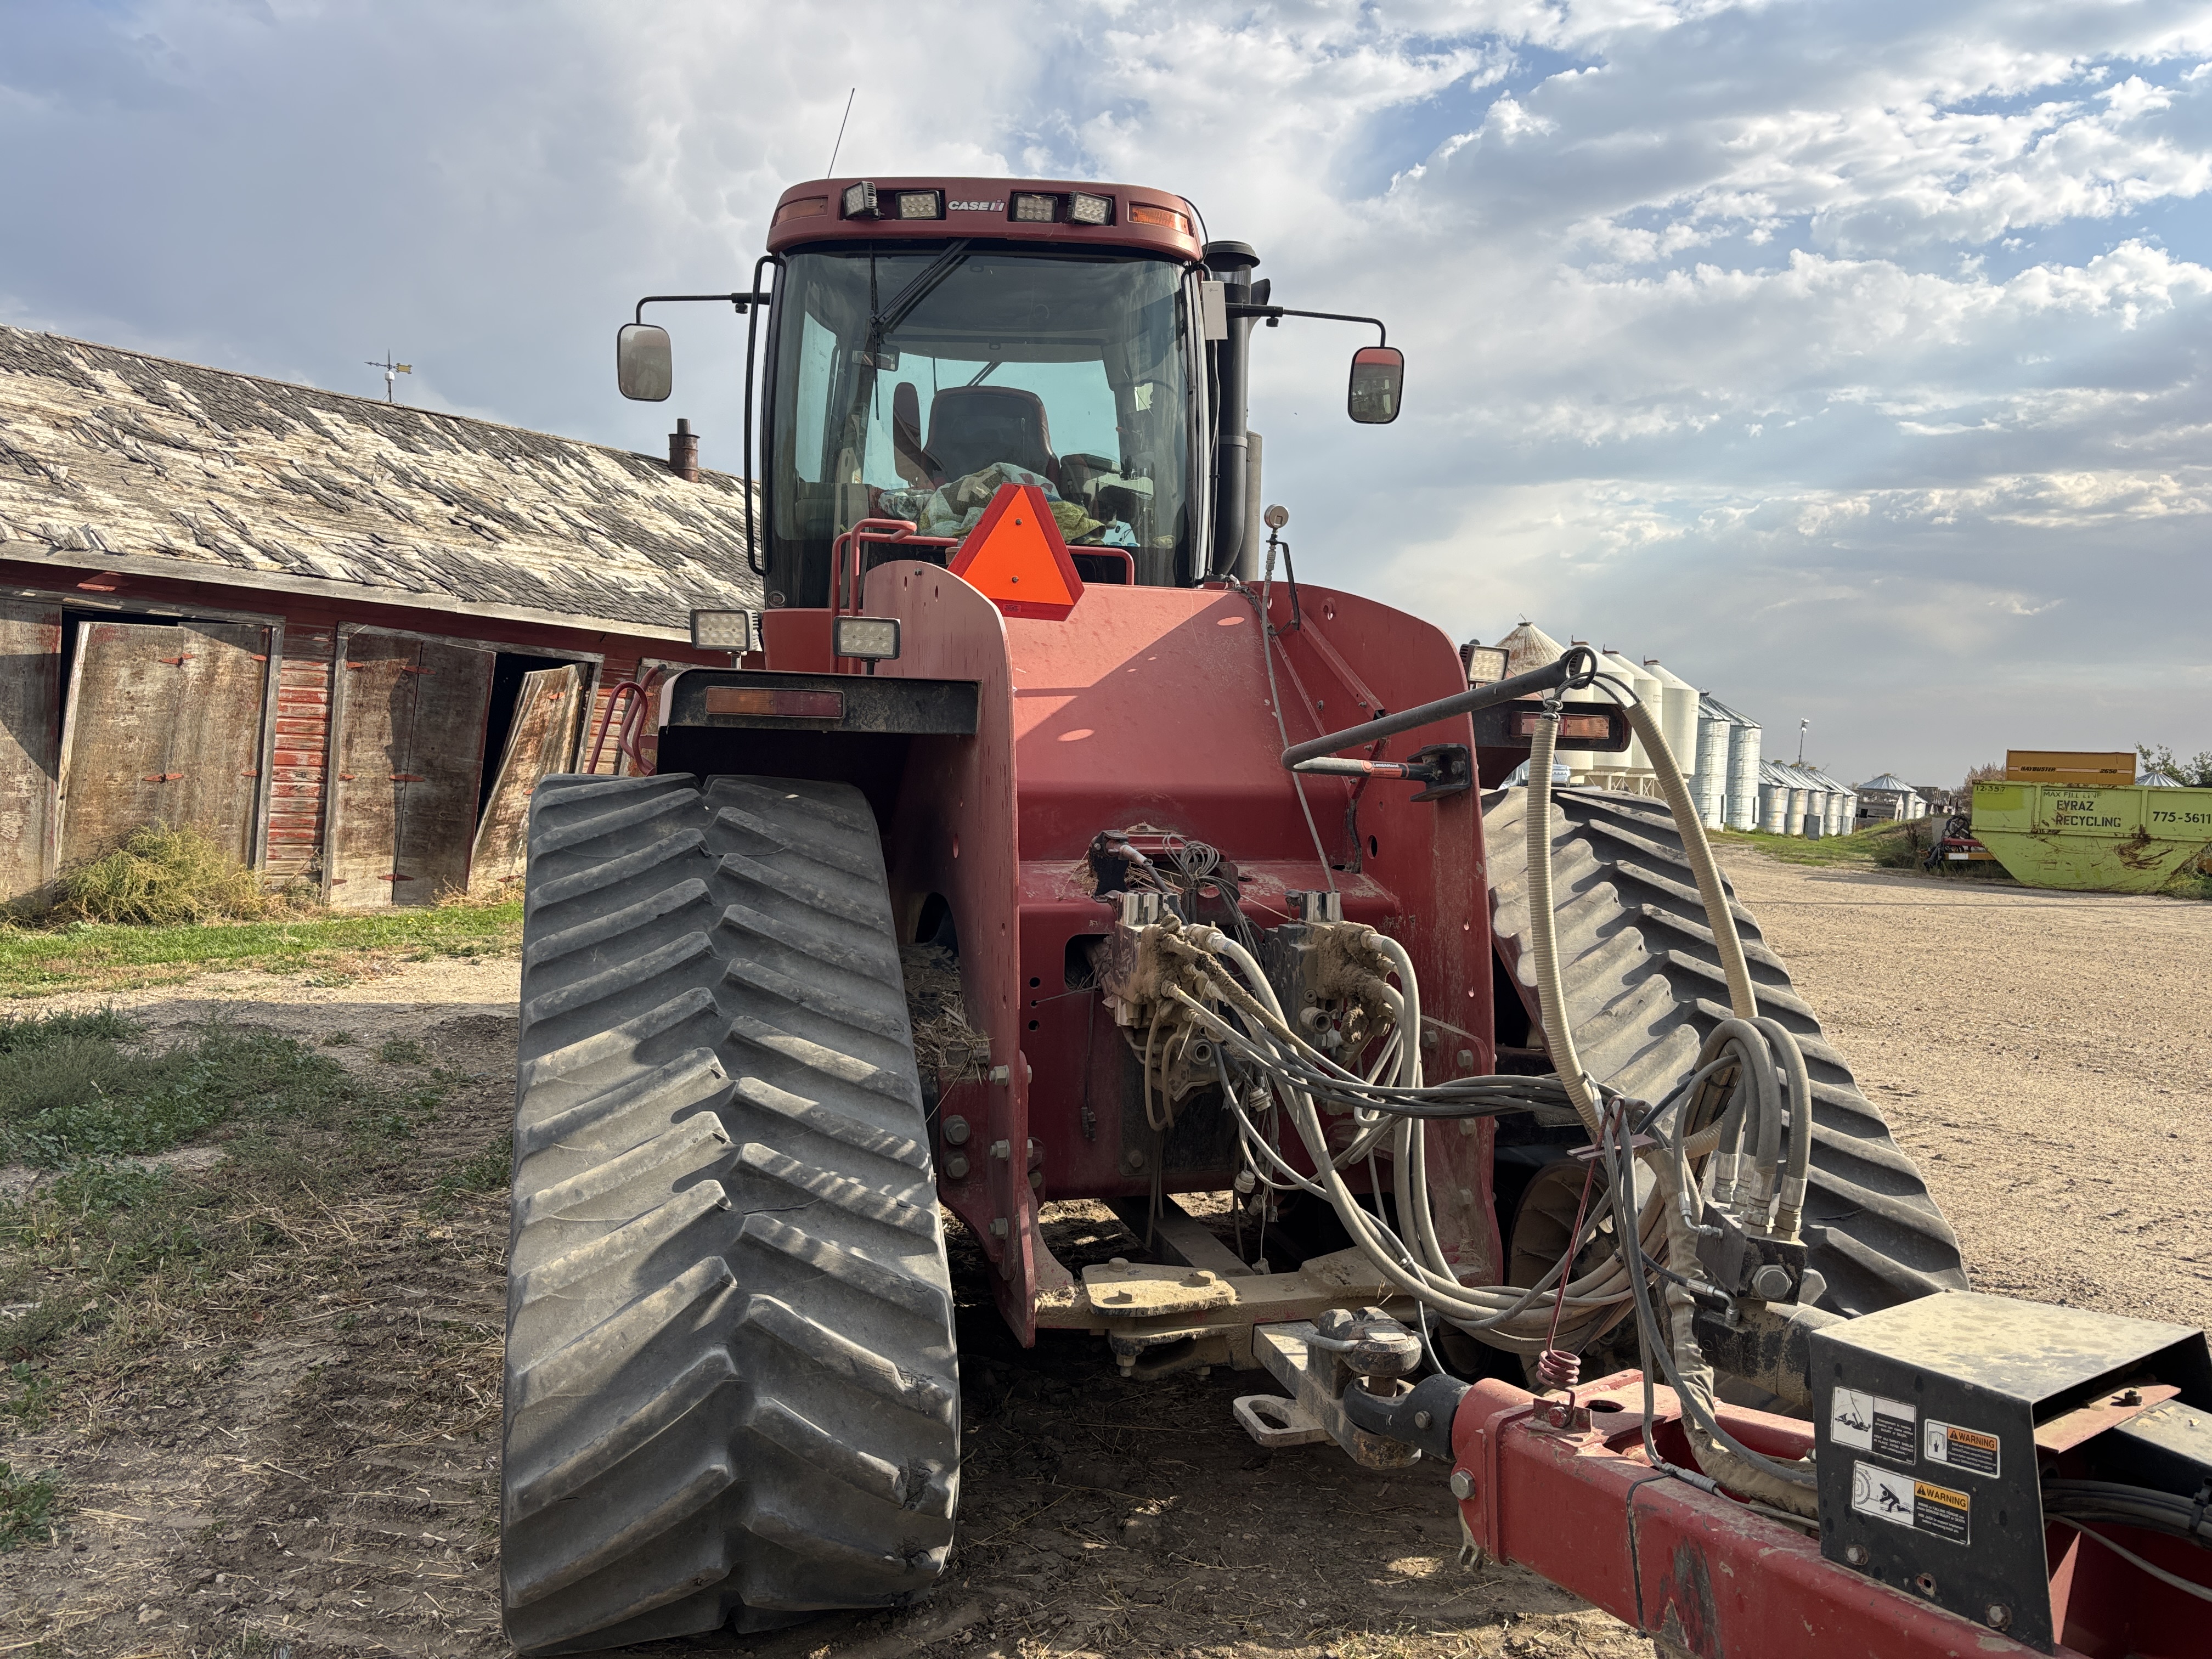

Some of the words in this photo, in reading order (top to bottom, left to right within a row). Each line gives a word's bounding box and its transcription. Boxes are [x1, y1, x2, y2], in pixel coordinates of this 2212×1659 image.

[948, 201, 990, 211] CASE
[2057, 800, 2094, 811] EVRAZ
[2056, 815, 2121, 827] RECYCLING
[2153, 811, 2211, 824] 775-3611
[1959, 1432, 1994, 1449] WARNING
[1927, 1488, 1966, 1508] WARNING
